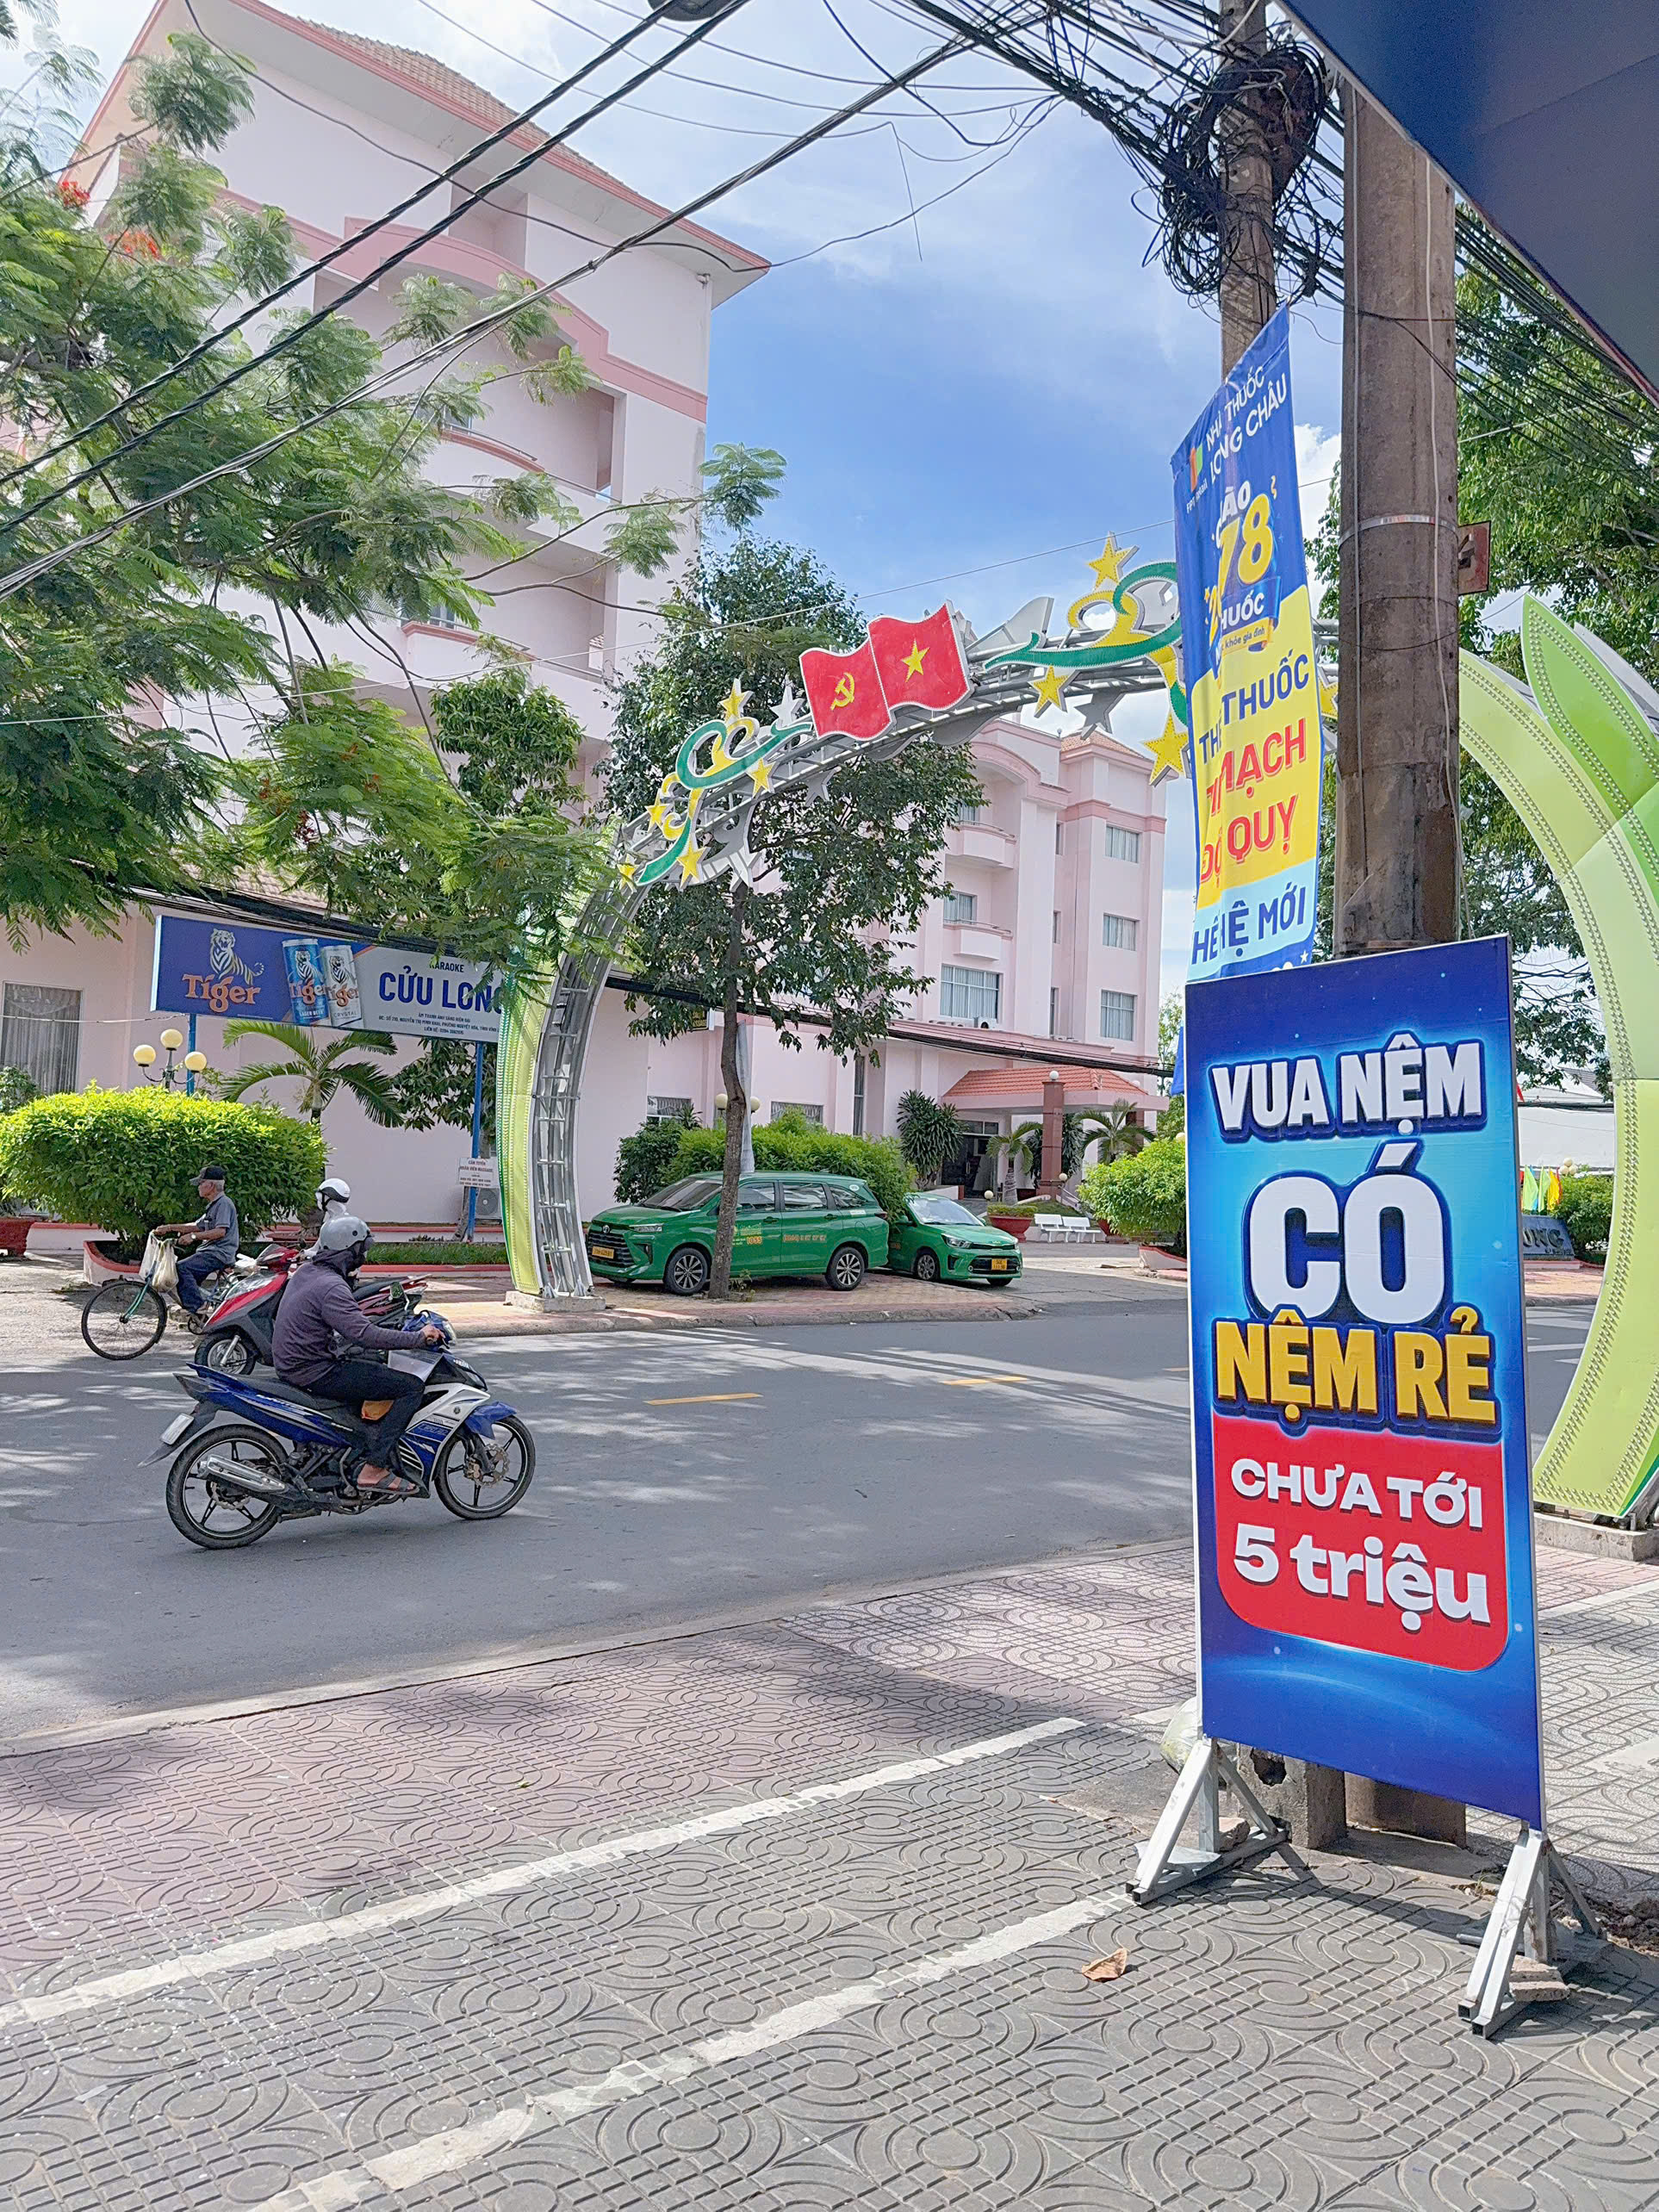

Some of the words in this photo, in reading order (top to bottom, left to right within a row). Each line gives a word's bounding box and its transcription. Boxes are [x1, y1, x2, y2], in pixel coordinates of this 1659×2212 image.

[1224, 365, 1264, 421] THUỐC
[1246, 372, 1287, 437] CHÂU
[1221, 589, 1265, 631] HUỐC
[1225, 636, 1241, 649] khỏe
[1243, 630, 1252, 644] gia
[1253, 624, 1265, 638] đình
[1221, 648, 1309, 726] THUỐC
[1227, 794, 1299, 864] QUỴ
[1258, 881, 1306, 936] MỚI
[182, 973, 261, 1013] Tiger
[379, 966, 433, 1006] CỬU
[1211, 1057, 1328, 1130] VUA
[1340, 1033, 1482, 1135] NỆM
[1250, 1141, 1444, 1324] CÓ
[1214, 1312, 1377, 1421] NỆM
[1395, 1306, 1496, 1426] RẺ
[1231, 1457, 1382, 1517] CHƯA
[1387, 1469, 1482, 1531] TỚI
[1234, 1524, 1279, 1587] 5
[1290, 1533, 1491, 1633] triệu
